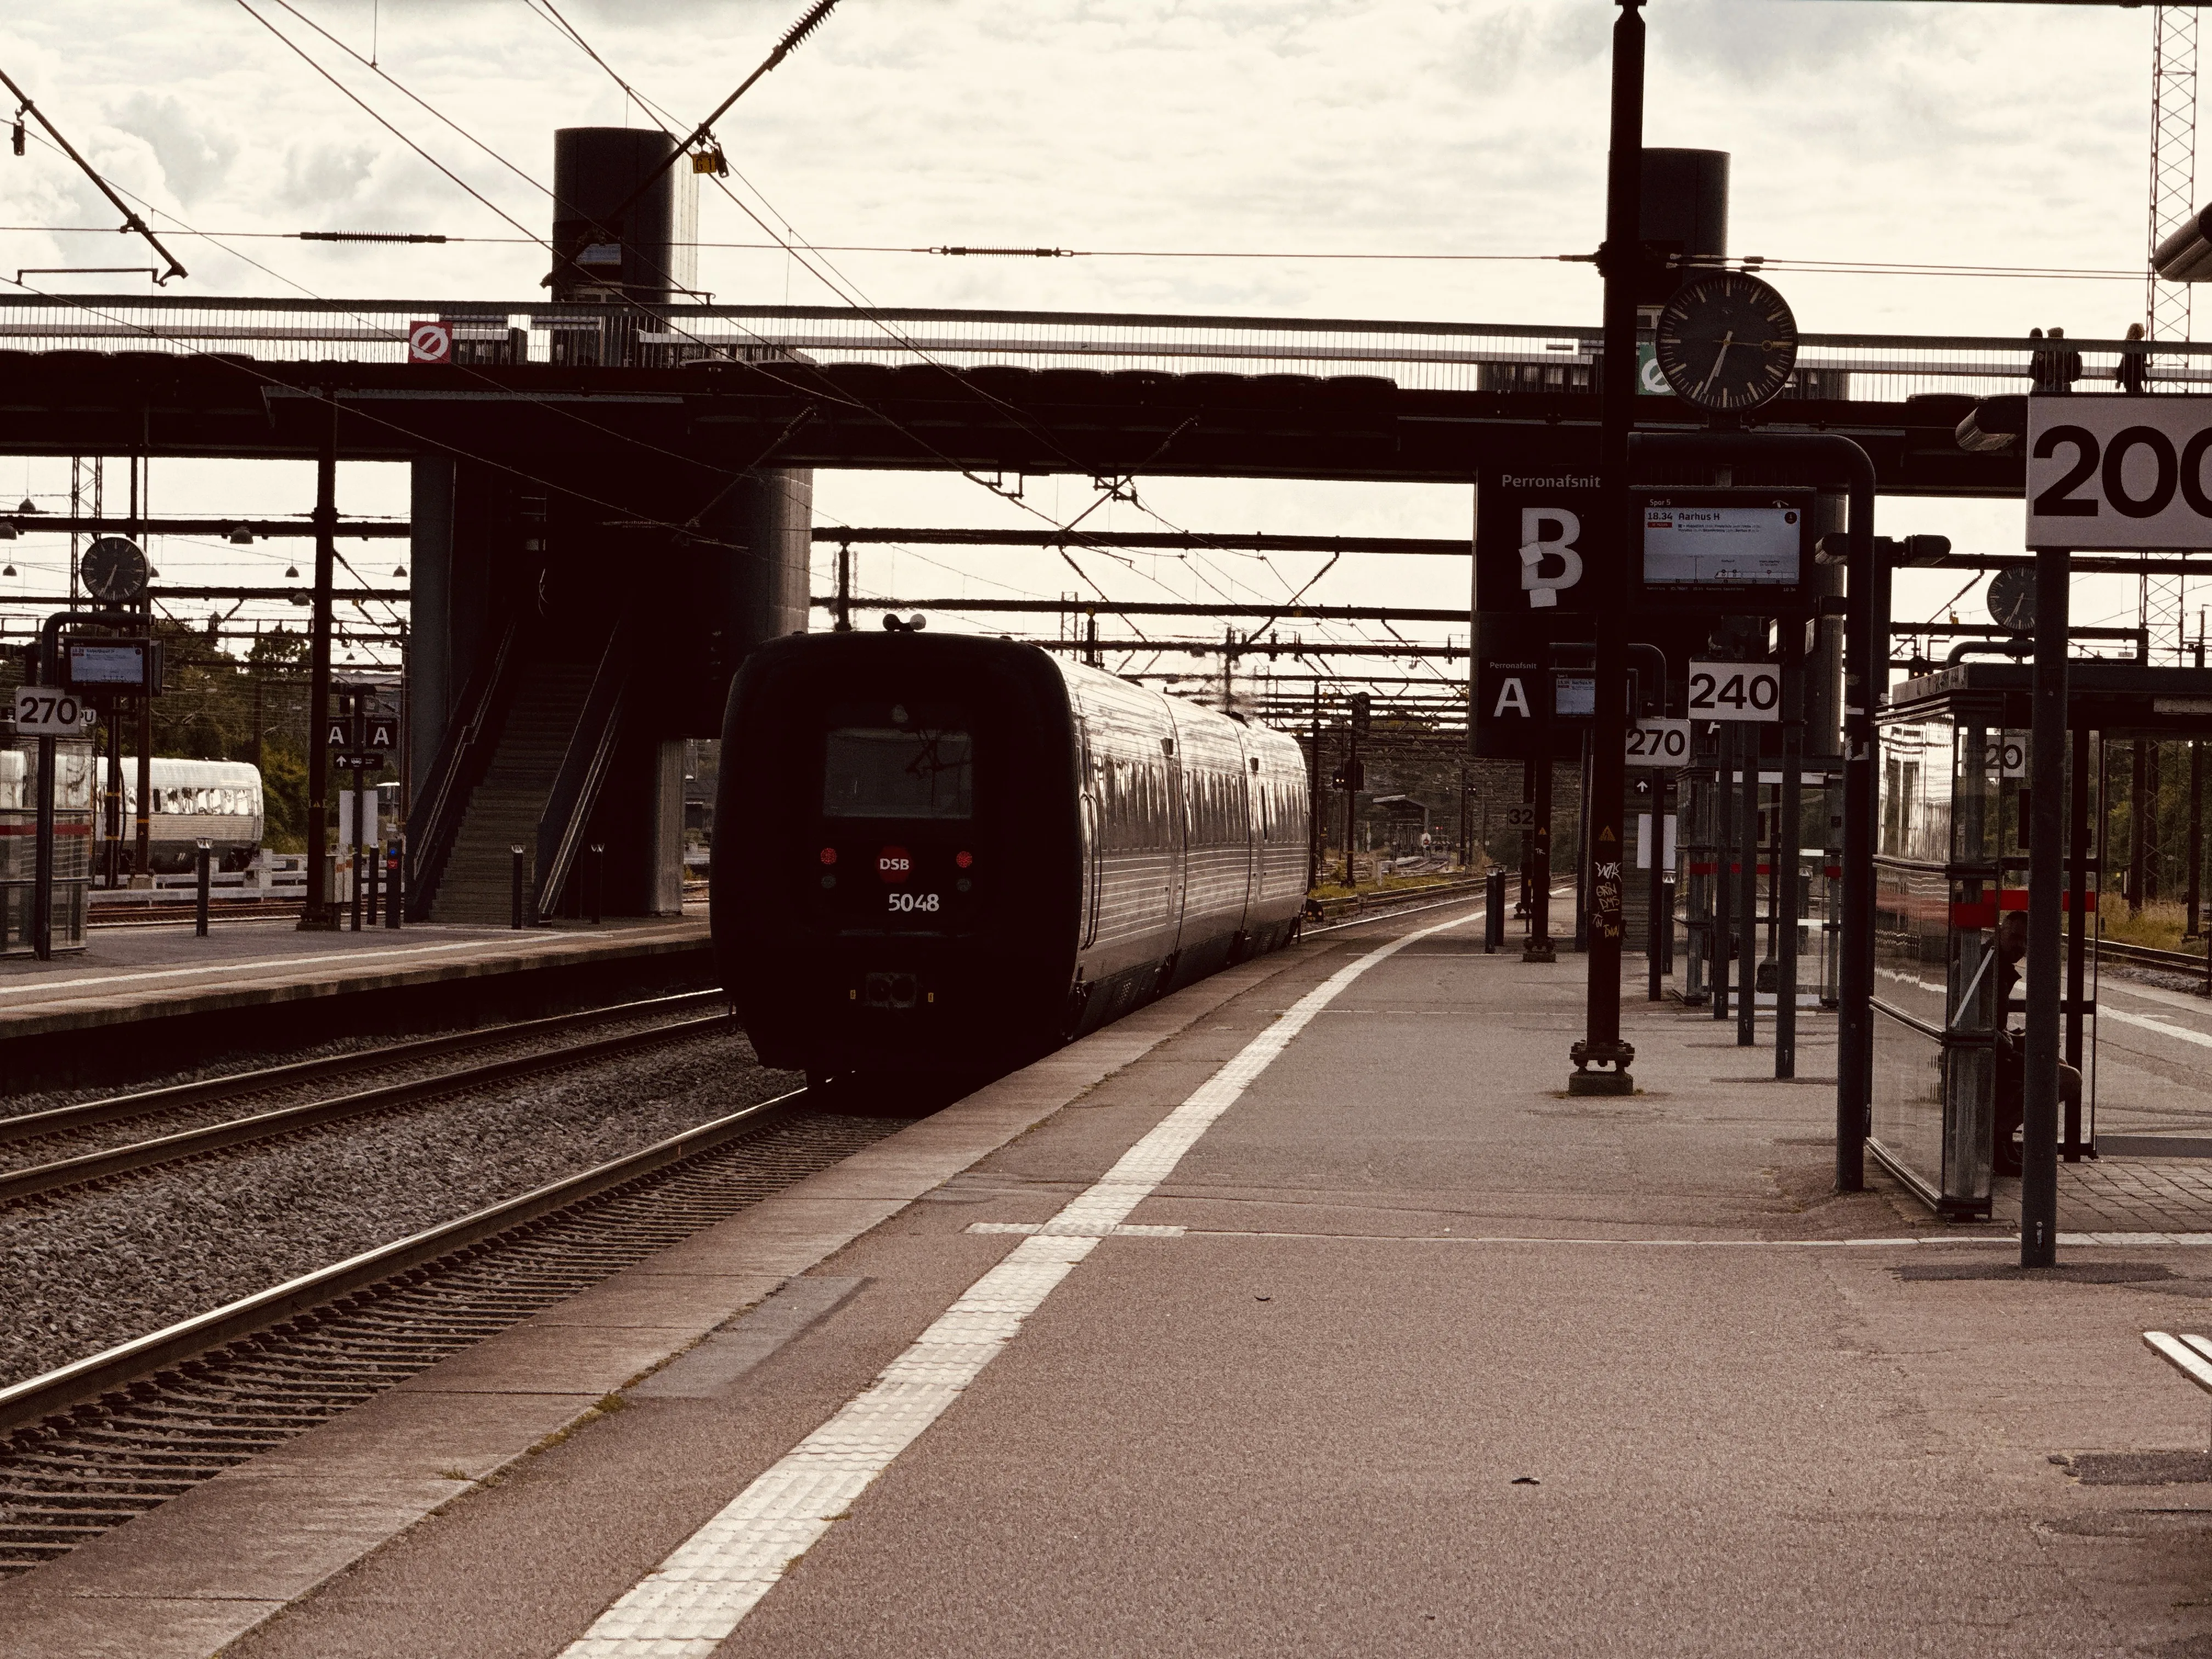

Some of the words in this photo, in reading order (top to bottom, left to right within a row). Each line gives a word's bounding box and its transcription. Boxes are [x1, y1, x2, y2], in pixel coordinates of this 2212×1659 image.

[1502, 474, 1601, 488] Perronafsnit
[1521, 507, 1583, 590] B
[1493, 678, 1531, 718] A
[1690, 673, 1779, 710] 240
[20, 696, 77, 725] 270
[328, 726, 345, 744] A
[373, 726, 390, 745] A
[1627, 729, 1685, 757] 270
[1509, 808, 1533, 825] 32
[879, 858, 910, 871] DSB
[888, 893, 940, 912] 5048
